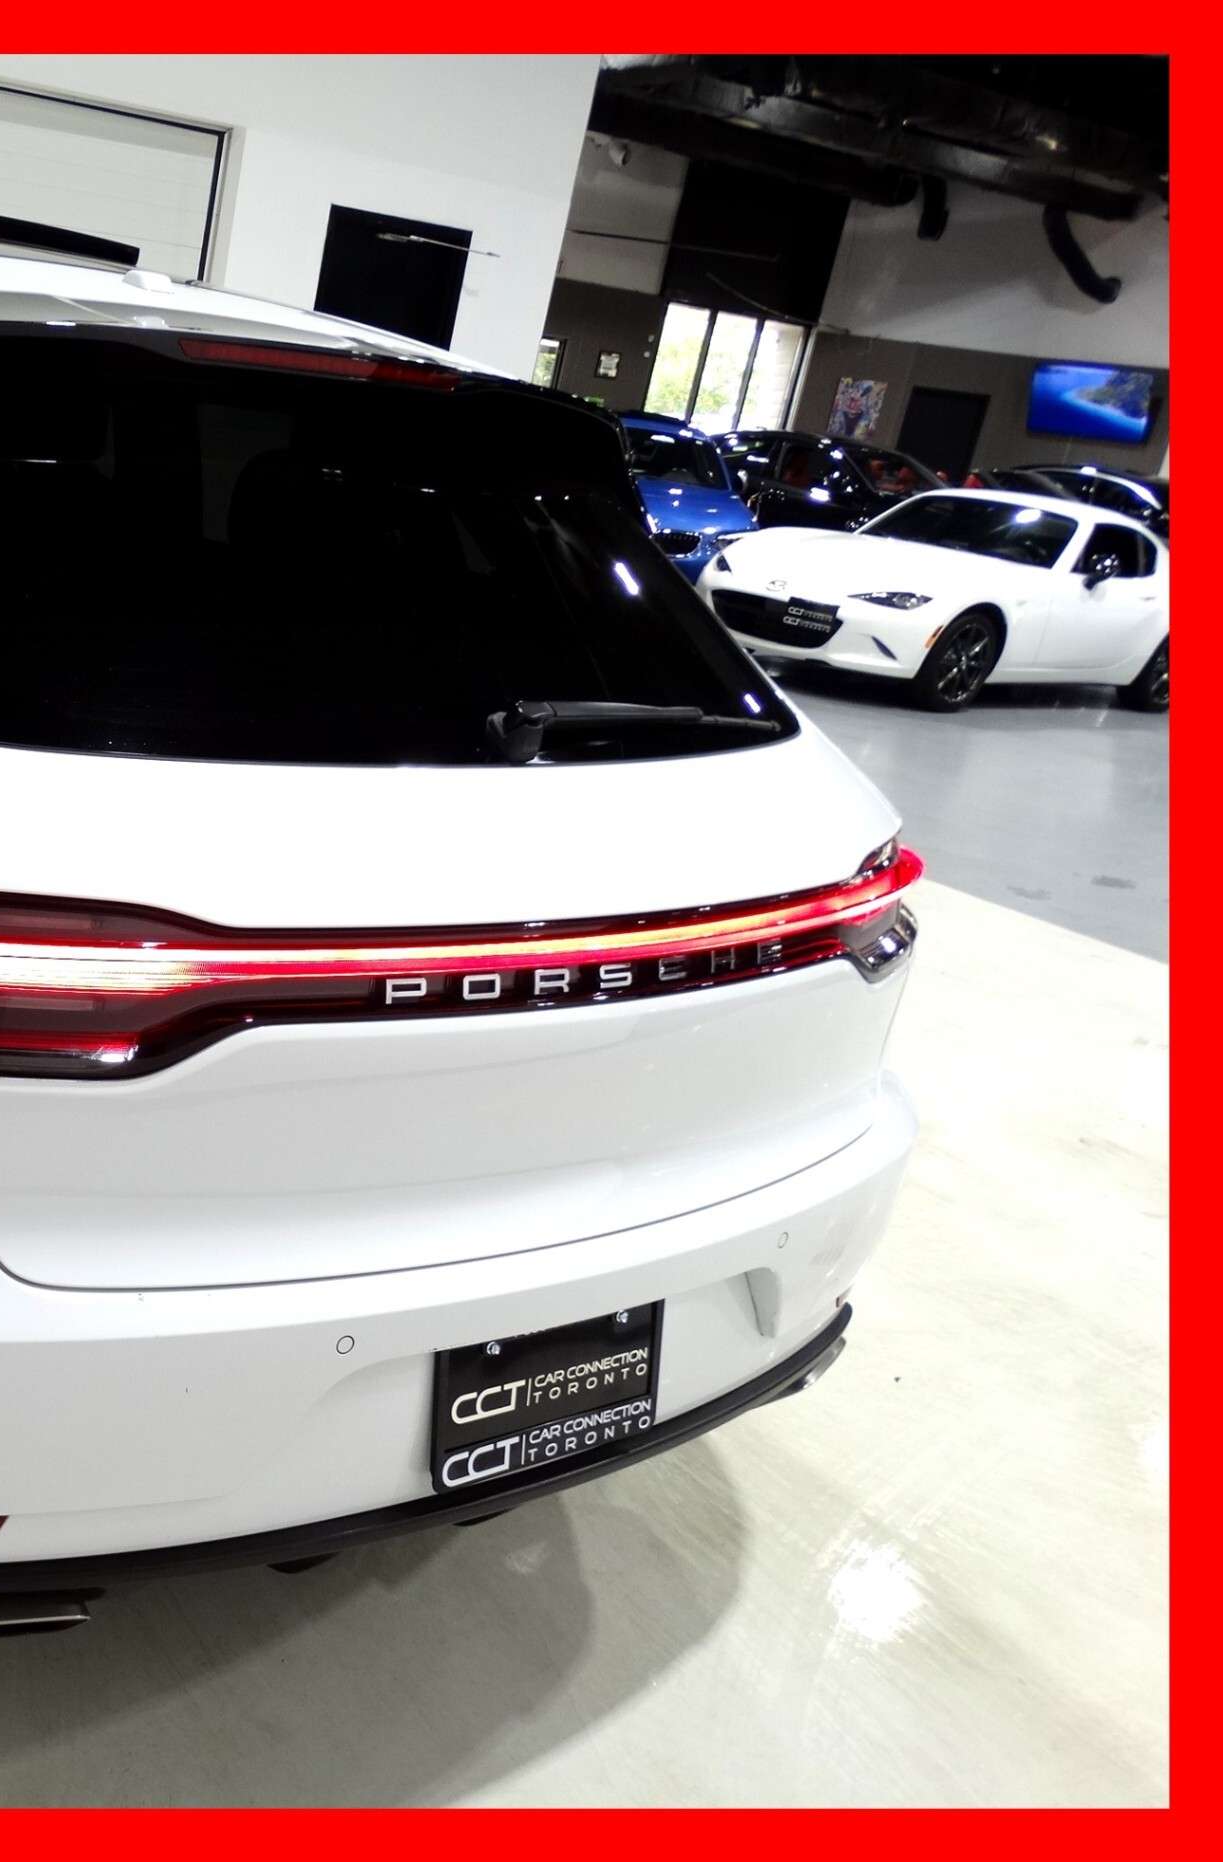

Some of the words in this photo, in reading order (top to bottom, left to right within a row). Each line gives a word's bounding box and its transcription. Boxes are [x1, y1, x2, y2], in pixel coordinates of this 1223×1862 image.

[385, 942, 782, 1004] PORSCHE
[532, 1363, 648, 1404] TORONTO
[534, 1370, 564, 1388] CAR
[566, 1347, 648, 1380] CONNECTION
[451, 1379, 525, 1424] CCT
[528, 1424, 562, 1444] CAR
[563, 1398, 652, 1434] CONNECTION
[442, 1436, 520, 1487] CCT
[528, 1415, 651, 1462] TORONTO
